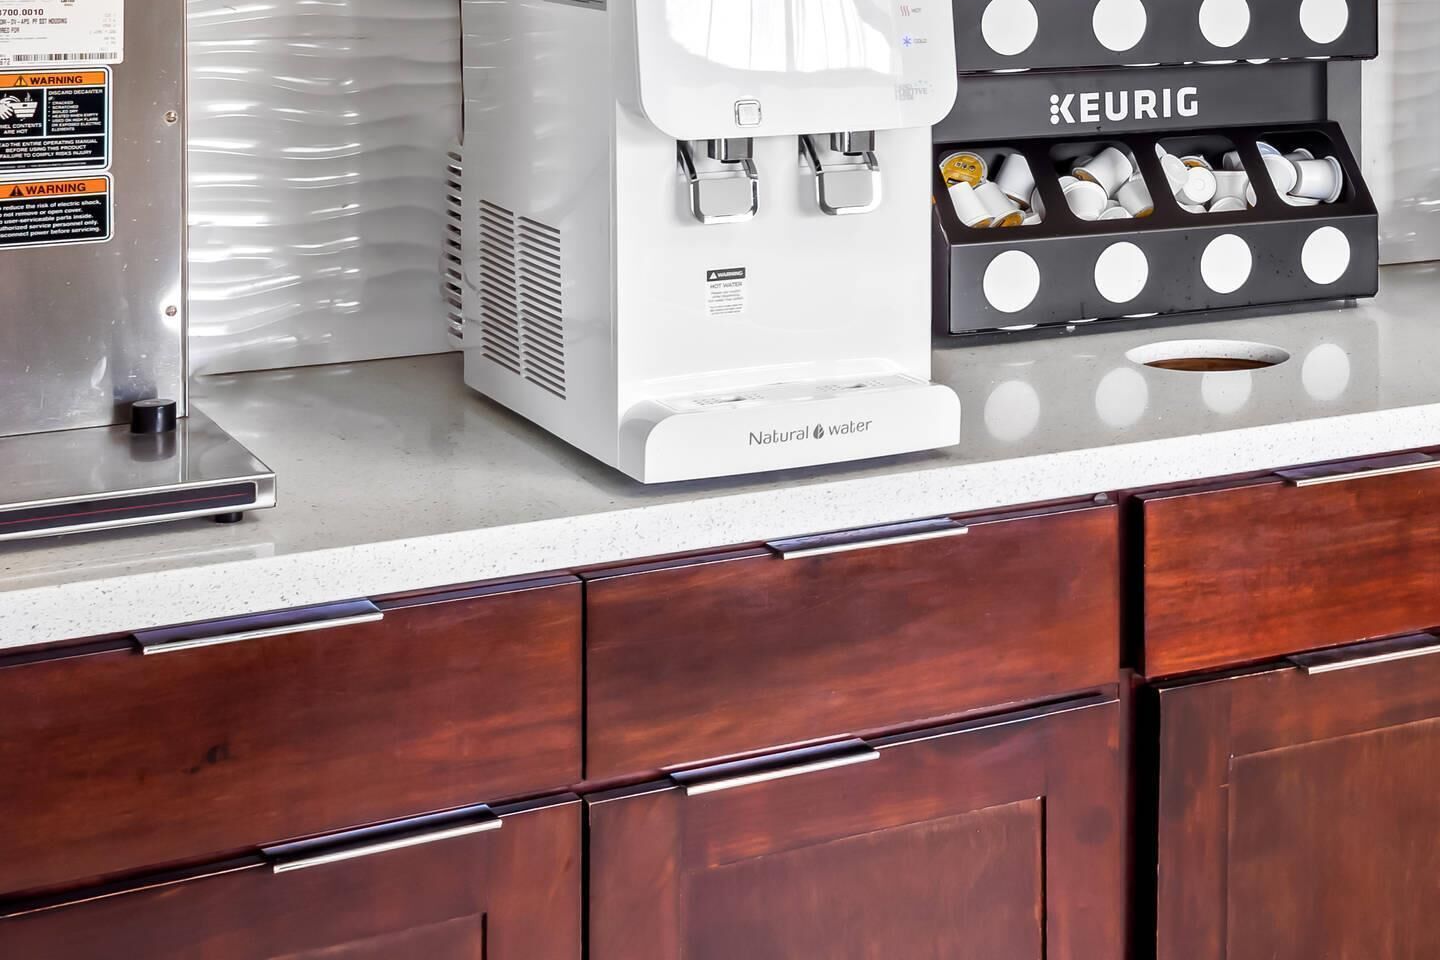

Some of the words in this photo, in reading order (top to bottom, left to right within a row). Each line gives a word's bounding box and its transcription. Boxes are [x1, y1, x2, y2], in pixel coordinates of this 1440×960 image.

[30, 76, 83, 84] WARNING
[1050, 87, 1198, 124] KEURIG
[26, 183, 86, 194] WARNING
[749, 426, 809, 445] Natural
[829, 420, 872, 436] water
